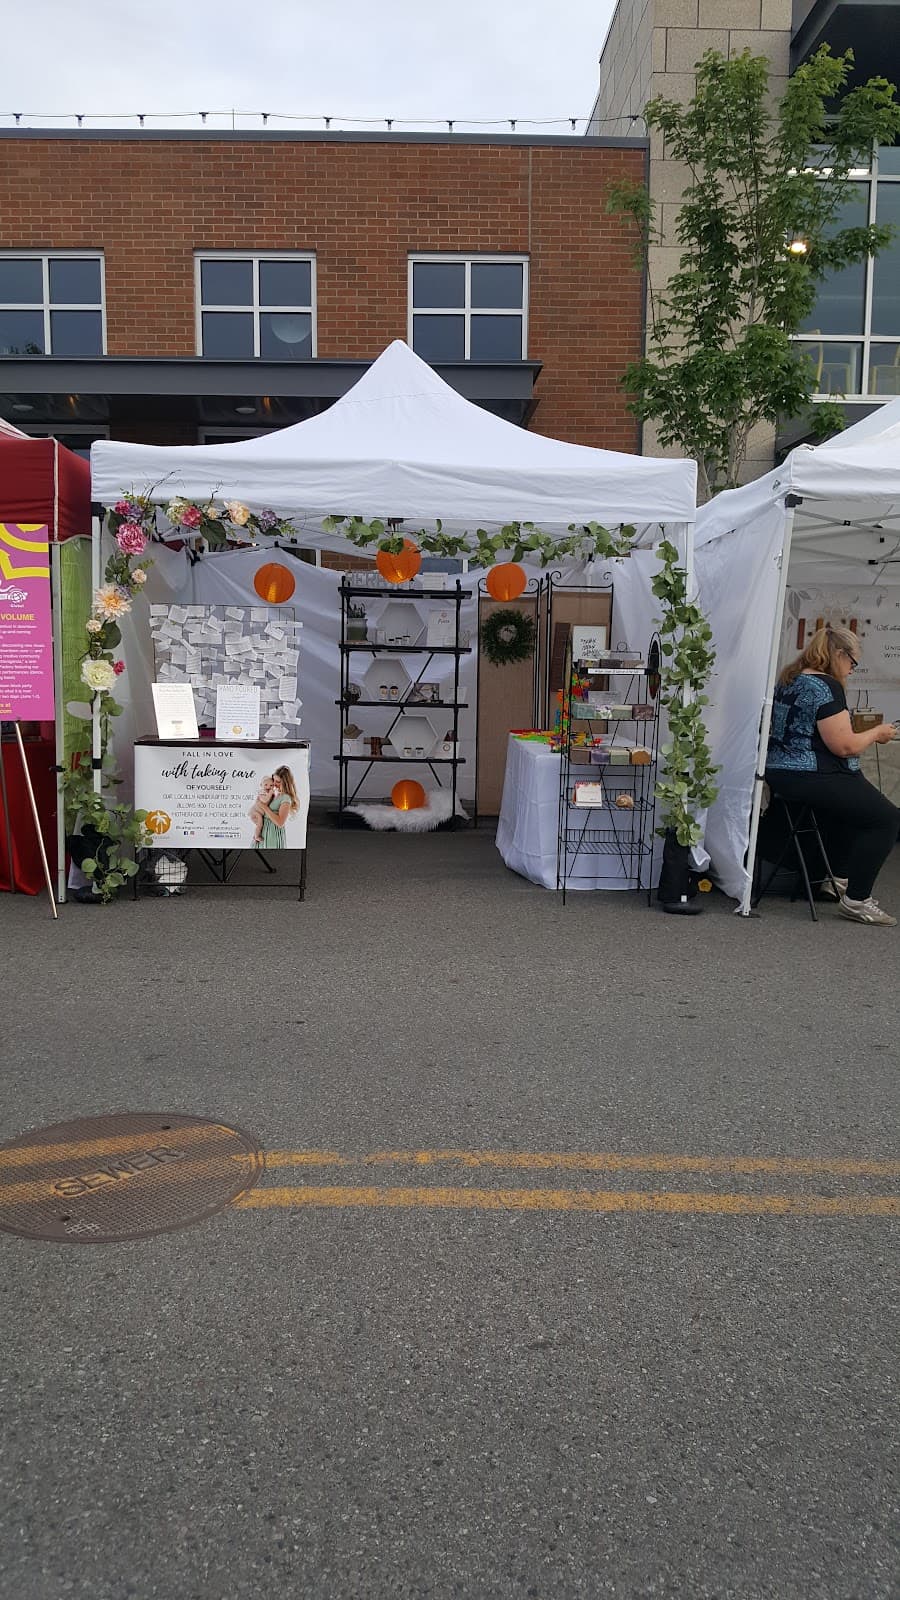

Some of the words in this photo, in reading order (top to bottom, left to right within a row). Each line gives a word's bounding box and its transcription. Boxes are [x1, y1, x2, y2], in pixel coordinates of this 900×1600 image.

[1, 613, 35, 621] VOLUME
[161, 760, 189, 779] with
[190, 763, 229, 784] taking
[231, 769, 256, 779] care
[53, 1145, 186, 1198] SEWER
